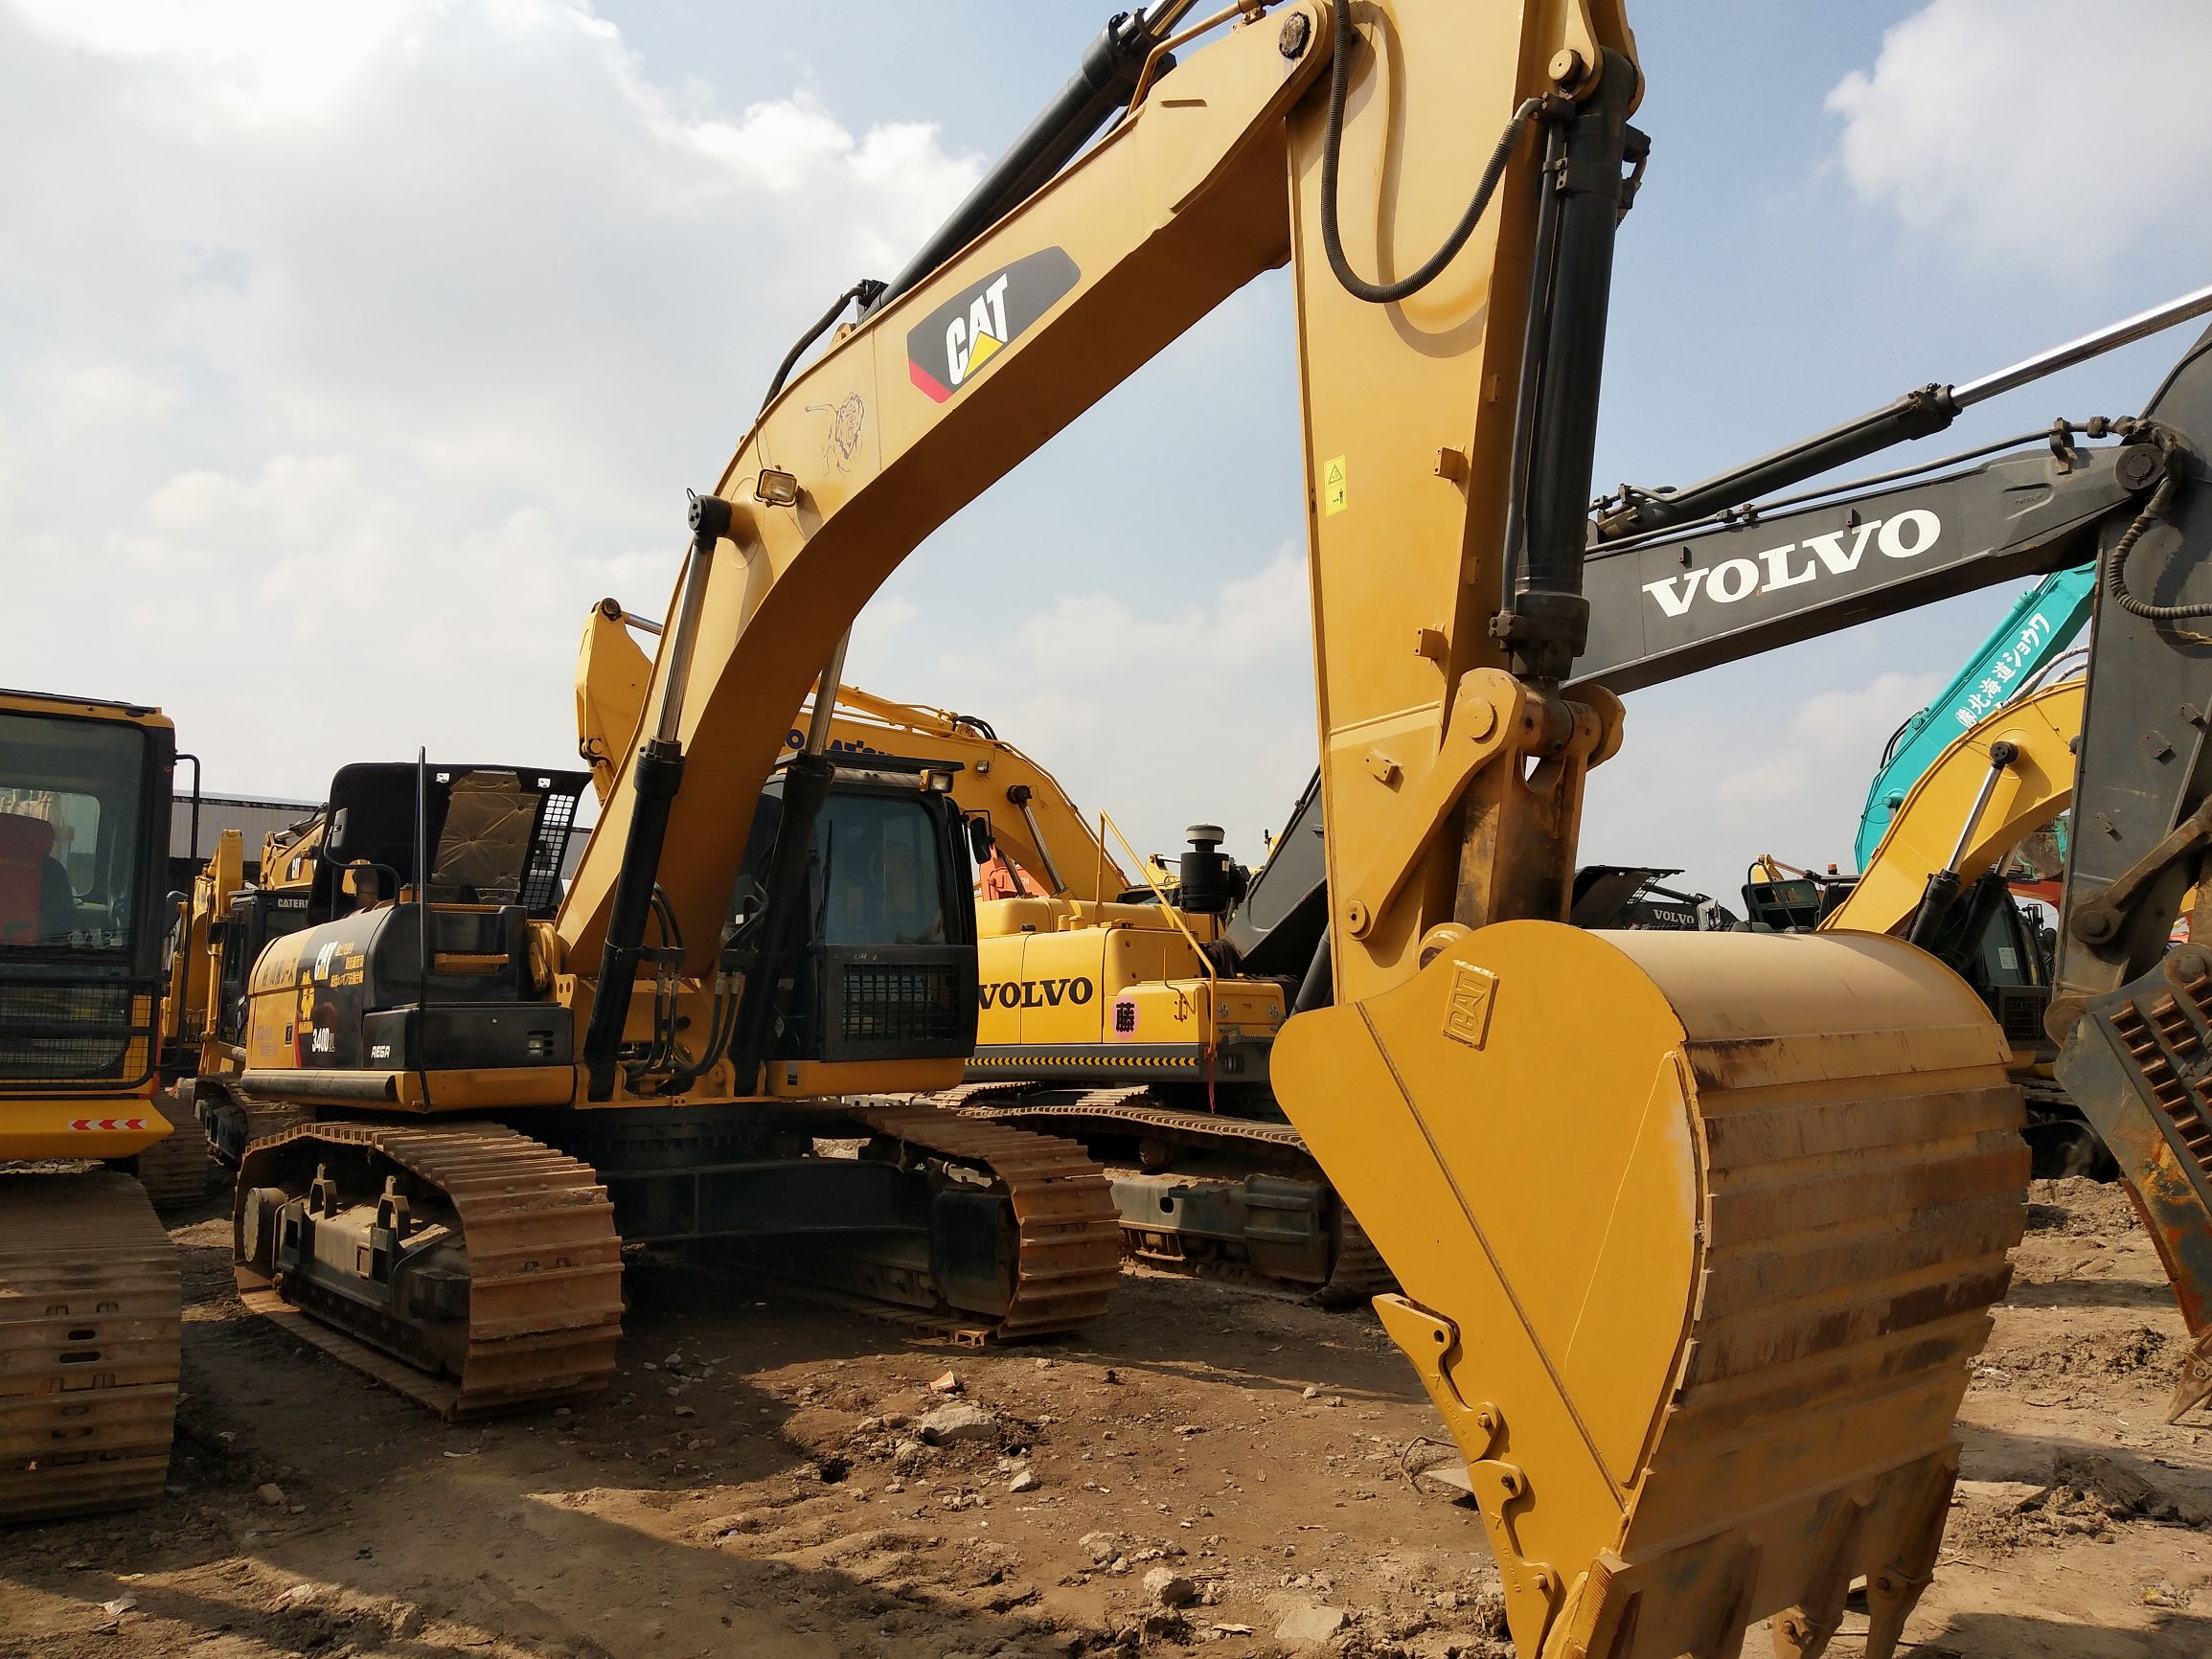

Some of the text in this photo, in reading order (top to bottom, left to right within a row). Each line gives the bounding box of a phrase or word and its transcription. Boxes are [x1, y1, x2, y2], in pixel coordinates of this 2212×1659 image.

[946, 273, 1008, 385] CAT
[1642, 509, 1941, 618] VOLVO
[1653, 908, 1695, 925] VOLVO
[314, 941, 339, 981] CAT
[978, 976, 1093, 1010] VOLVO
